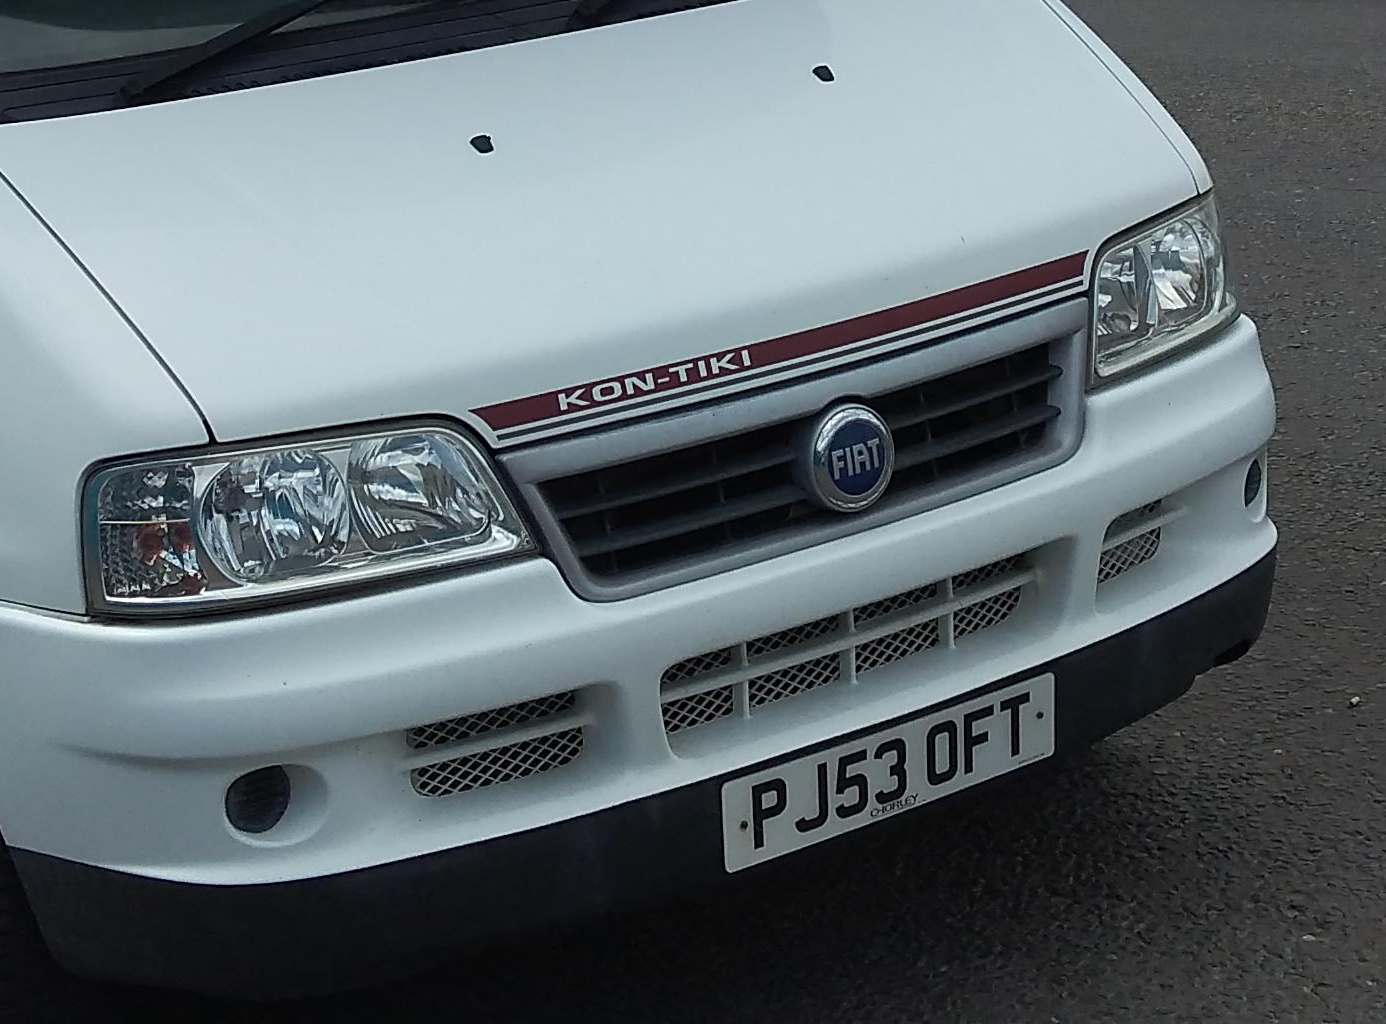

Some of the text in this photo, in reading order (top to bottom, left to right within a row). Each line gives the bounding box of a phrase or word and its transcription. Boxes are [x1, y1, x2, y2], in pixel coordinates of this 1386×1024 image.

[557, 349, 752, 411] KON-TIKI
[831, 437, 880, 481] FIAT
[751, 691, 1031, 850] PJ53 OFT
